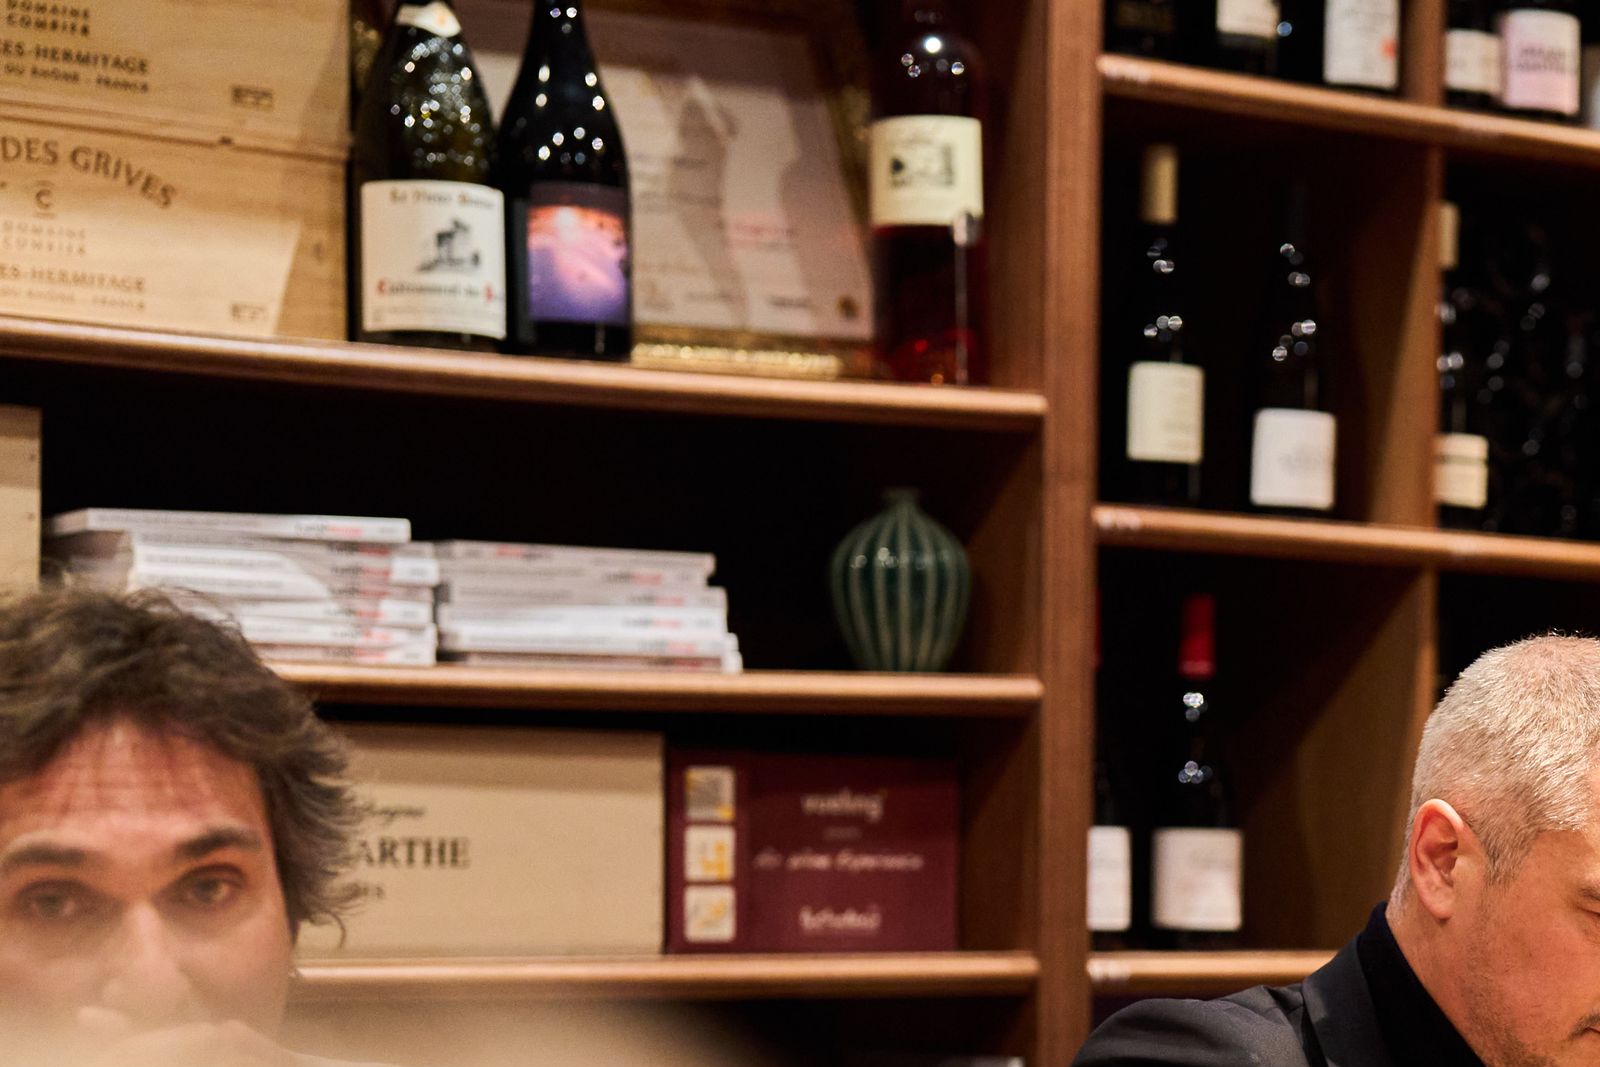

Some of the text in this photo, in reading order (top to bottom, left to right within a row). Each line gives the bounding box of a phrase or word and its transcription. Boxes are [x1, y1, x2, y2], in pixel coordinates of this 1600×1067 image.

[0, 134, 177, 210] DES GRIVES
[357, 835, 471, 869] ARTHE
